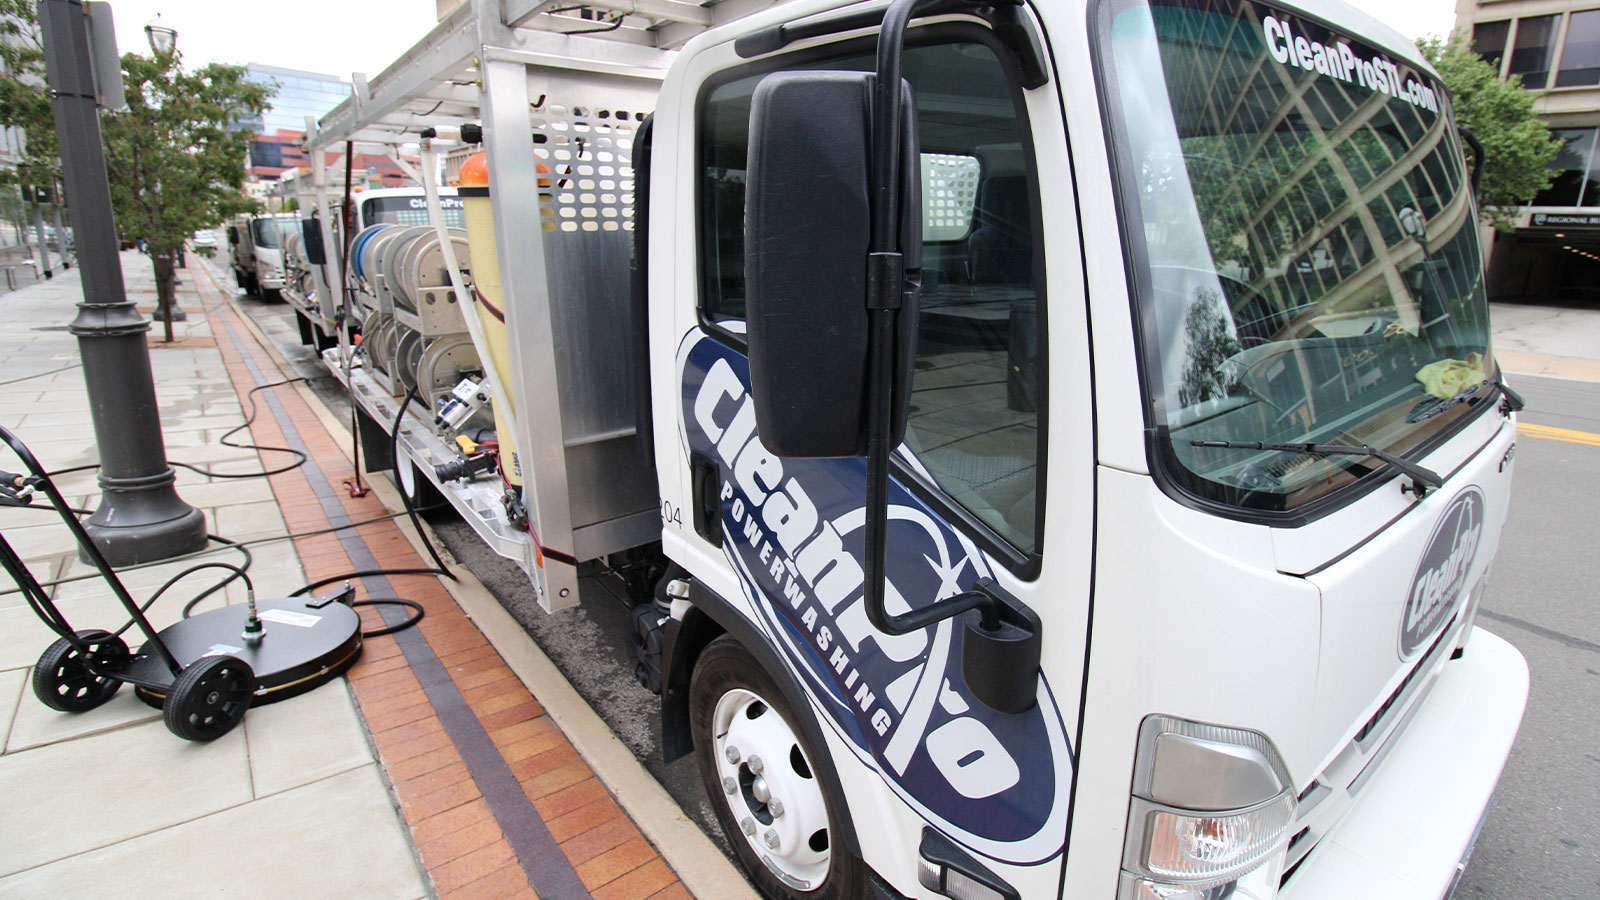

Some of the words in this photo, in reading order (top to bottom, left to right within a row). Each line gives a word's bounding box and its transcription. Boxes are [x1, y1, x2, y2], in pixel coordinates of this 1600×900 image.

[1263, 15, 1439, 113] CleanProSTL.com
[660, 497, 683, 530] 04
[693, 357, 1020, 799] CleanPro
[720, 480, 894, 738] POWERWASHING
